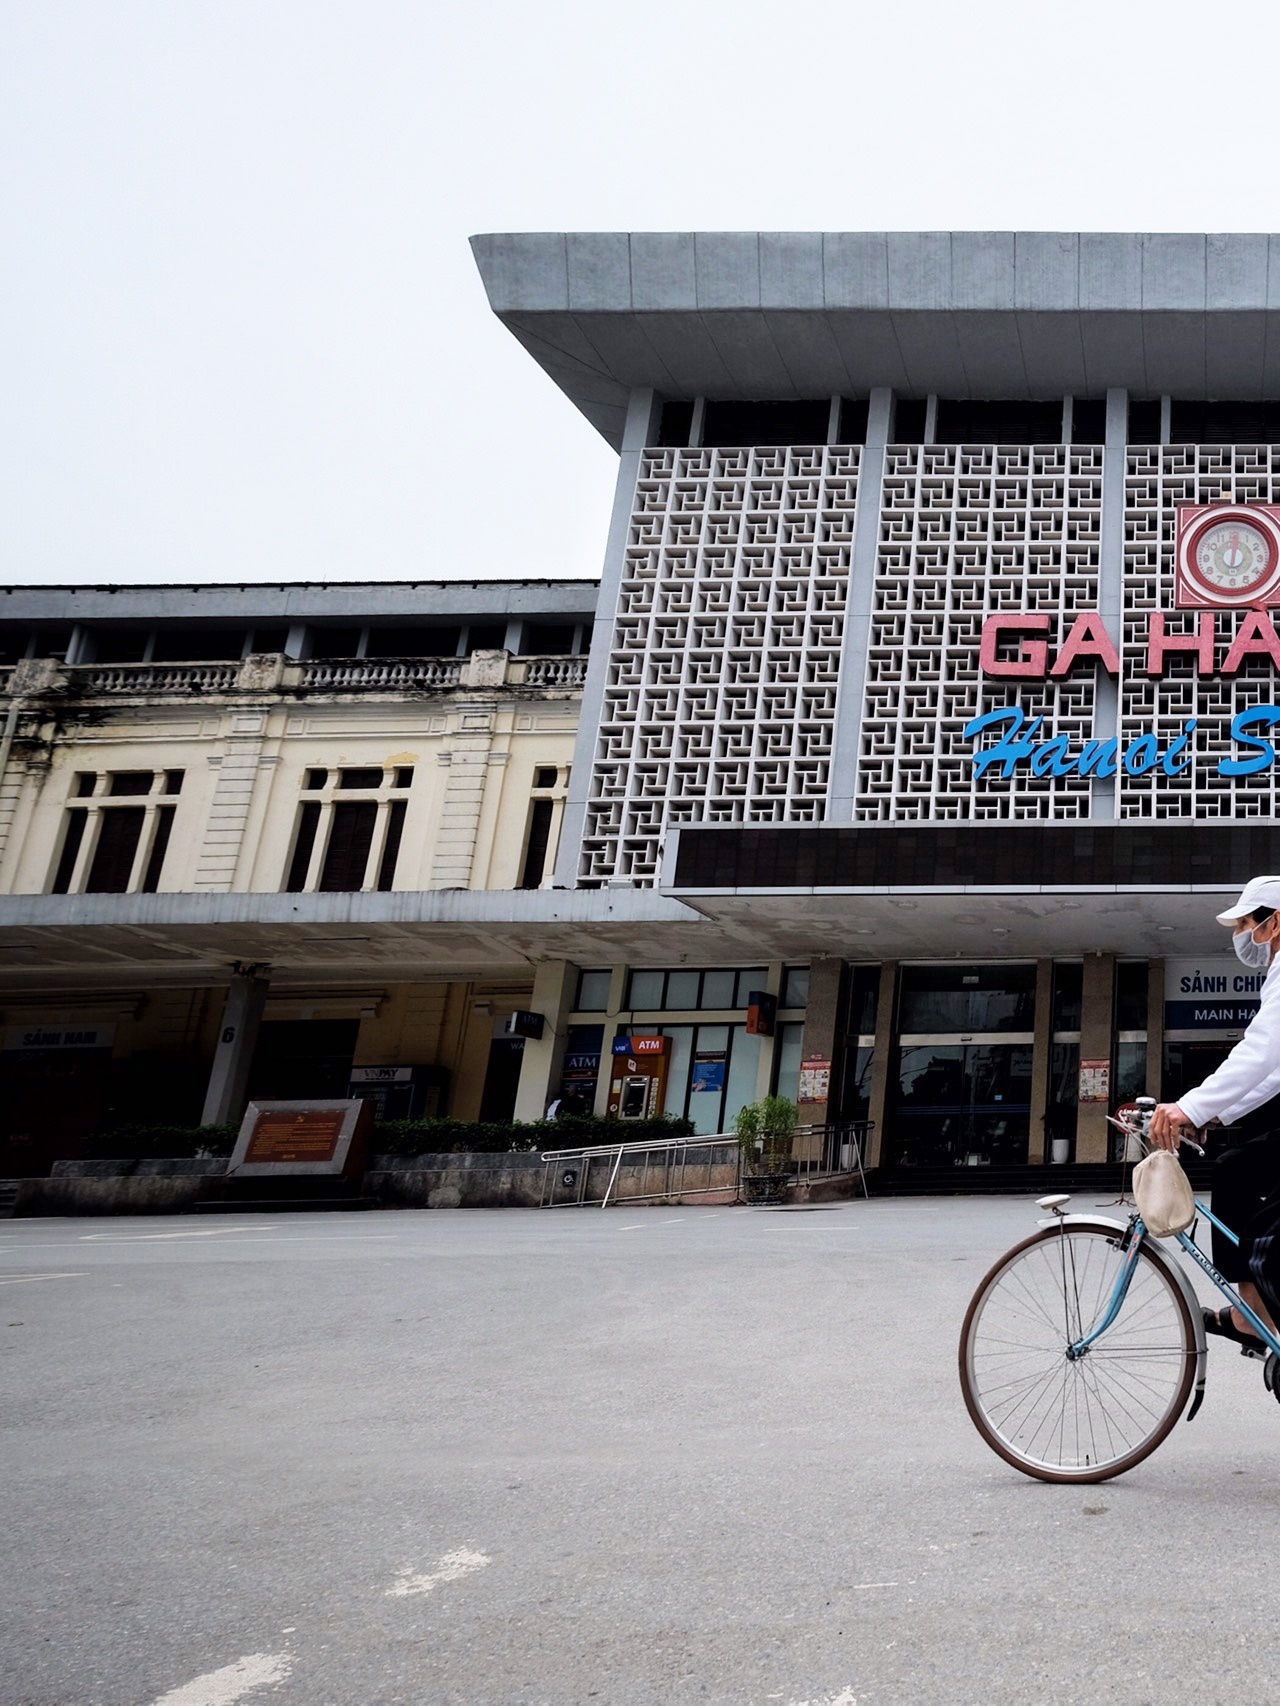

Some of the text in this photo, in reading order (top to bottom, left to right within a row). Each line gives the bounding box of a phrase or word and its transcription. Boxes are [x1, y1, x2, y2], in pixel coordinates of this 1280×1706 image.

[1217, 533, 1224, 543] 11
[1207, 543, 1217, 551] 10
[1253, 542, 1260, 551] 2
[1203, 554, 1210, 563] 9
[1256, 554, 1263, 563] 3
[1206, 566, 1213, 575] 8
[1251, 567, 1259, 575] 4
[1217, 575, 1223, 584] 7
[1229, 578, 1236, 586] 6
[1242, 575, 1249, 584] 5
[980, 612, 1120, 681] GA
[963, 706, 1198, 780] Hanoi
[1180, 970, 1227, 993] SẢNH
[1194, 1008, 1258, 1021] MAIN HA
[23, 1028, 97, 1047] SẢNH NAM
[222, 1027, 234, 1043] 6
[638, 1040, 660, 1050] ATM
[568, 1056, 597, 1068] ATM
[365, 1068, 399, 1078] VNPAY
